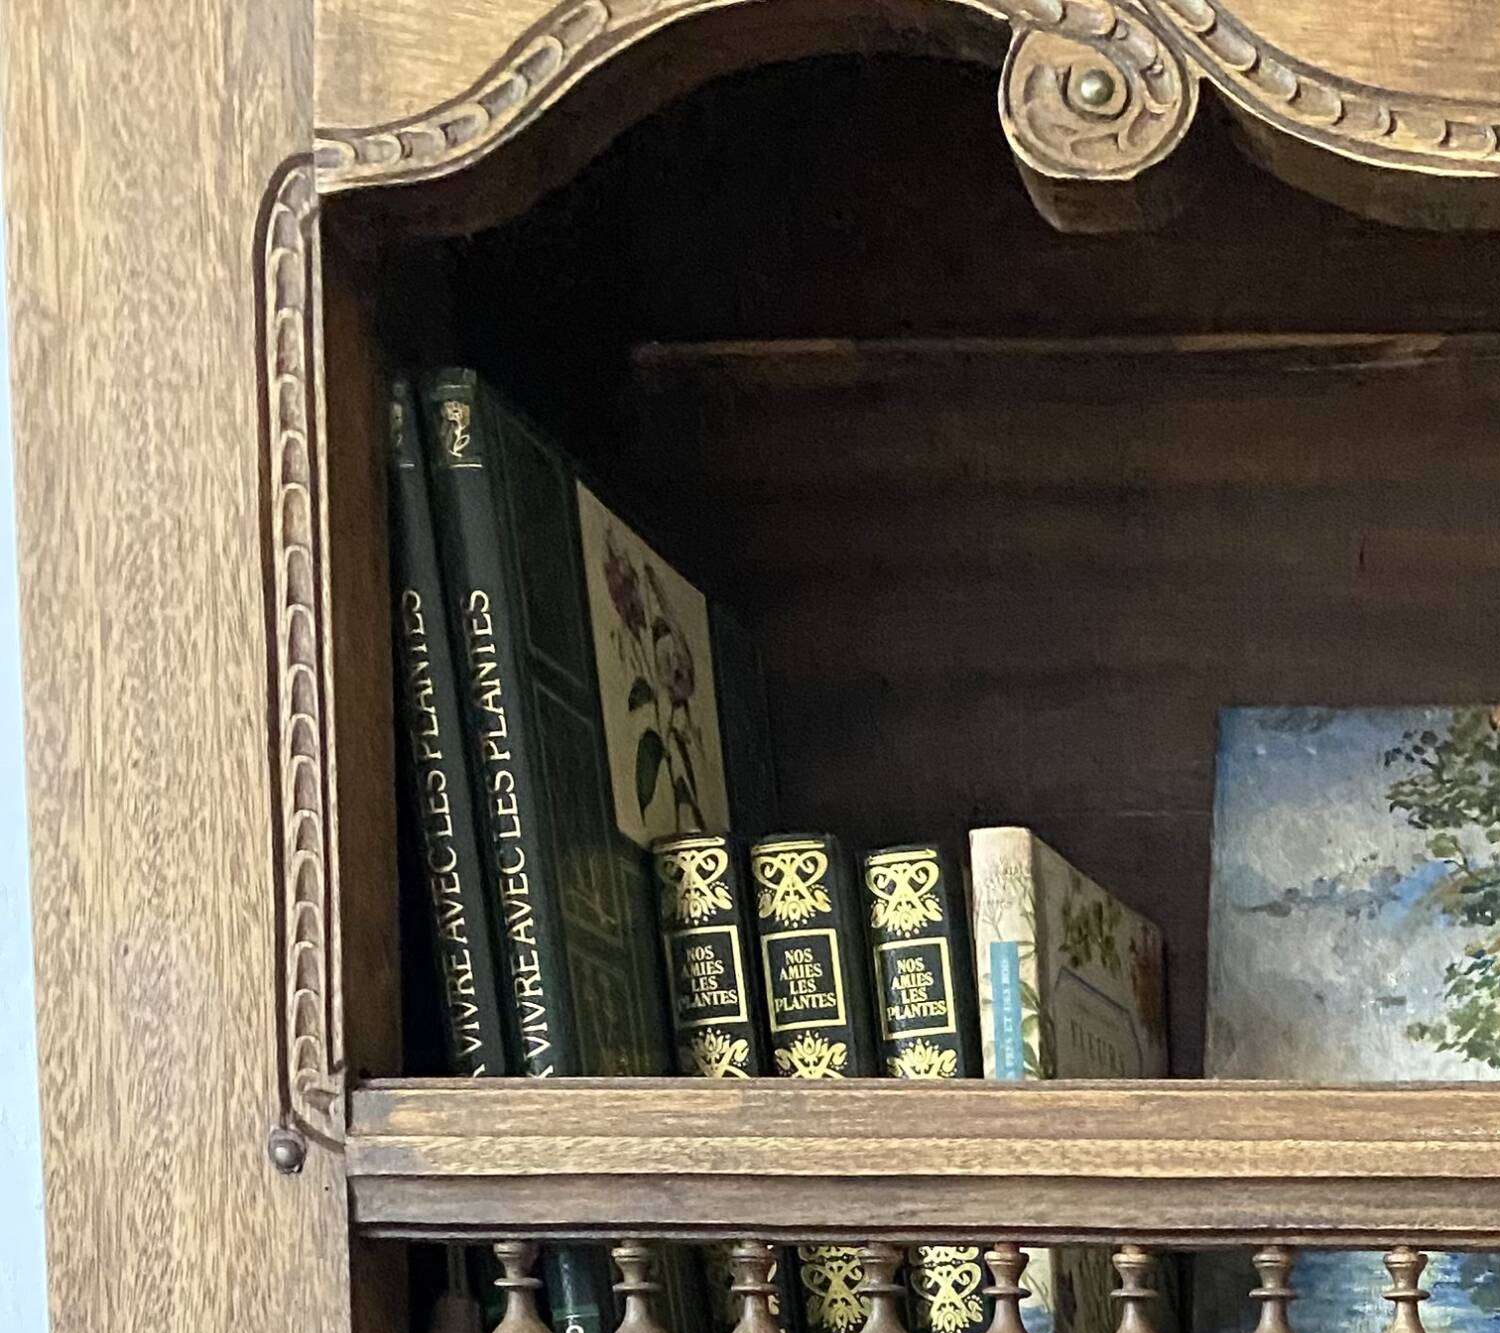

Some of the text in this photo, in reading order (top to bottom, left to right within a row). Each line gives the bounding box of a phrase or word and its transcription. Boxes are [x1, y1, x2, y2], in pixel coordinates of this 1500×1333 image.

[469, 589, 511, 761] PLANTES
[427, 769, 453, 837] LES
[494, 769, 522, 839] LES
[428, 845, 468, 944] AVEC
[499, 846, 536, 945] AVEC
[687, 945, 715, 962] NOS
[784, 948, 814, 965] NOS
[682, 960, 725, 978] AMIES
[779, 963, 823, 981] AMIES
[897, 957, 925, 975] NOS
[691, 975, 718, 992] LES
[789, 979, 817, 995] LES
[891, 972, 934, 990] AMIES
[449, 949, 482, 1058] VIVRE
[515, 949, 552, 1060] VIVRE
[775, 993, 836, 1012] PLANTES
[901, 987, 928, 1005] LES
[887, 1001, 947, 1020] PLANTES
